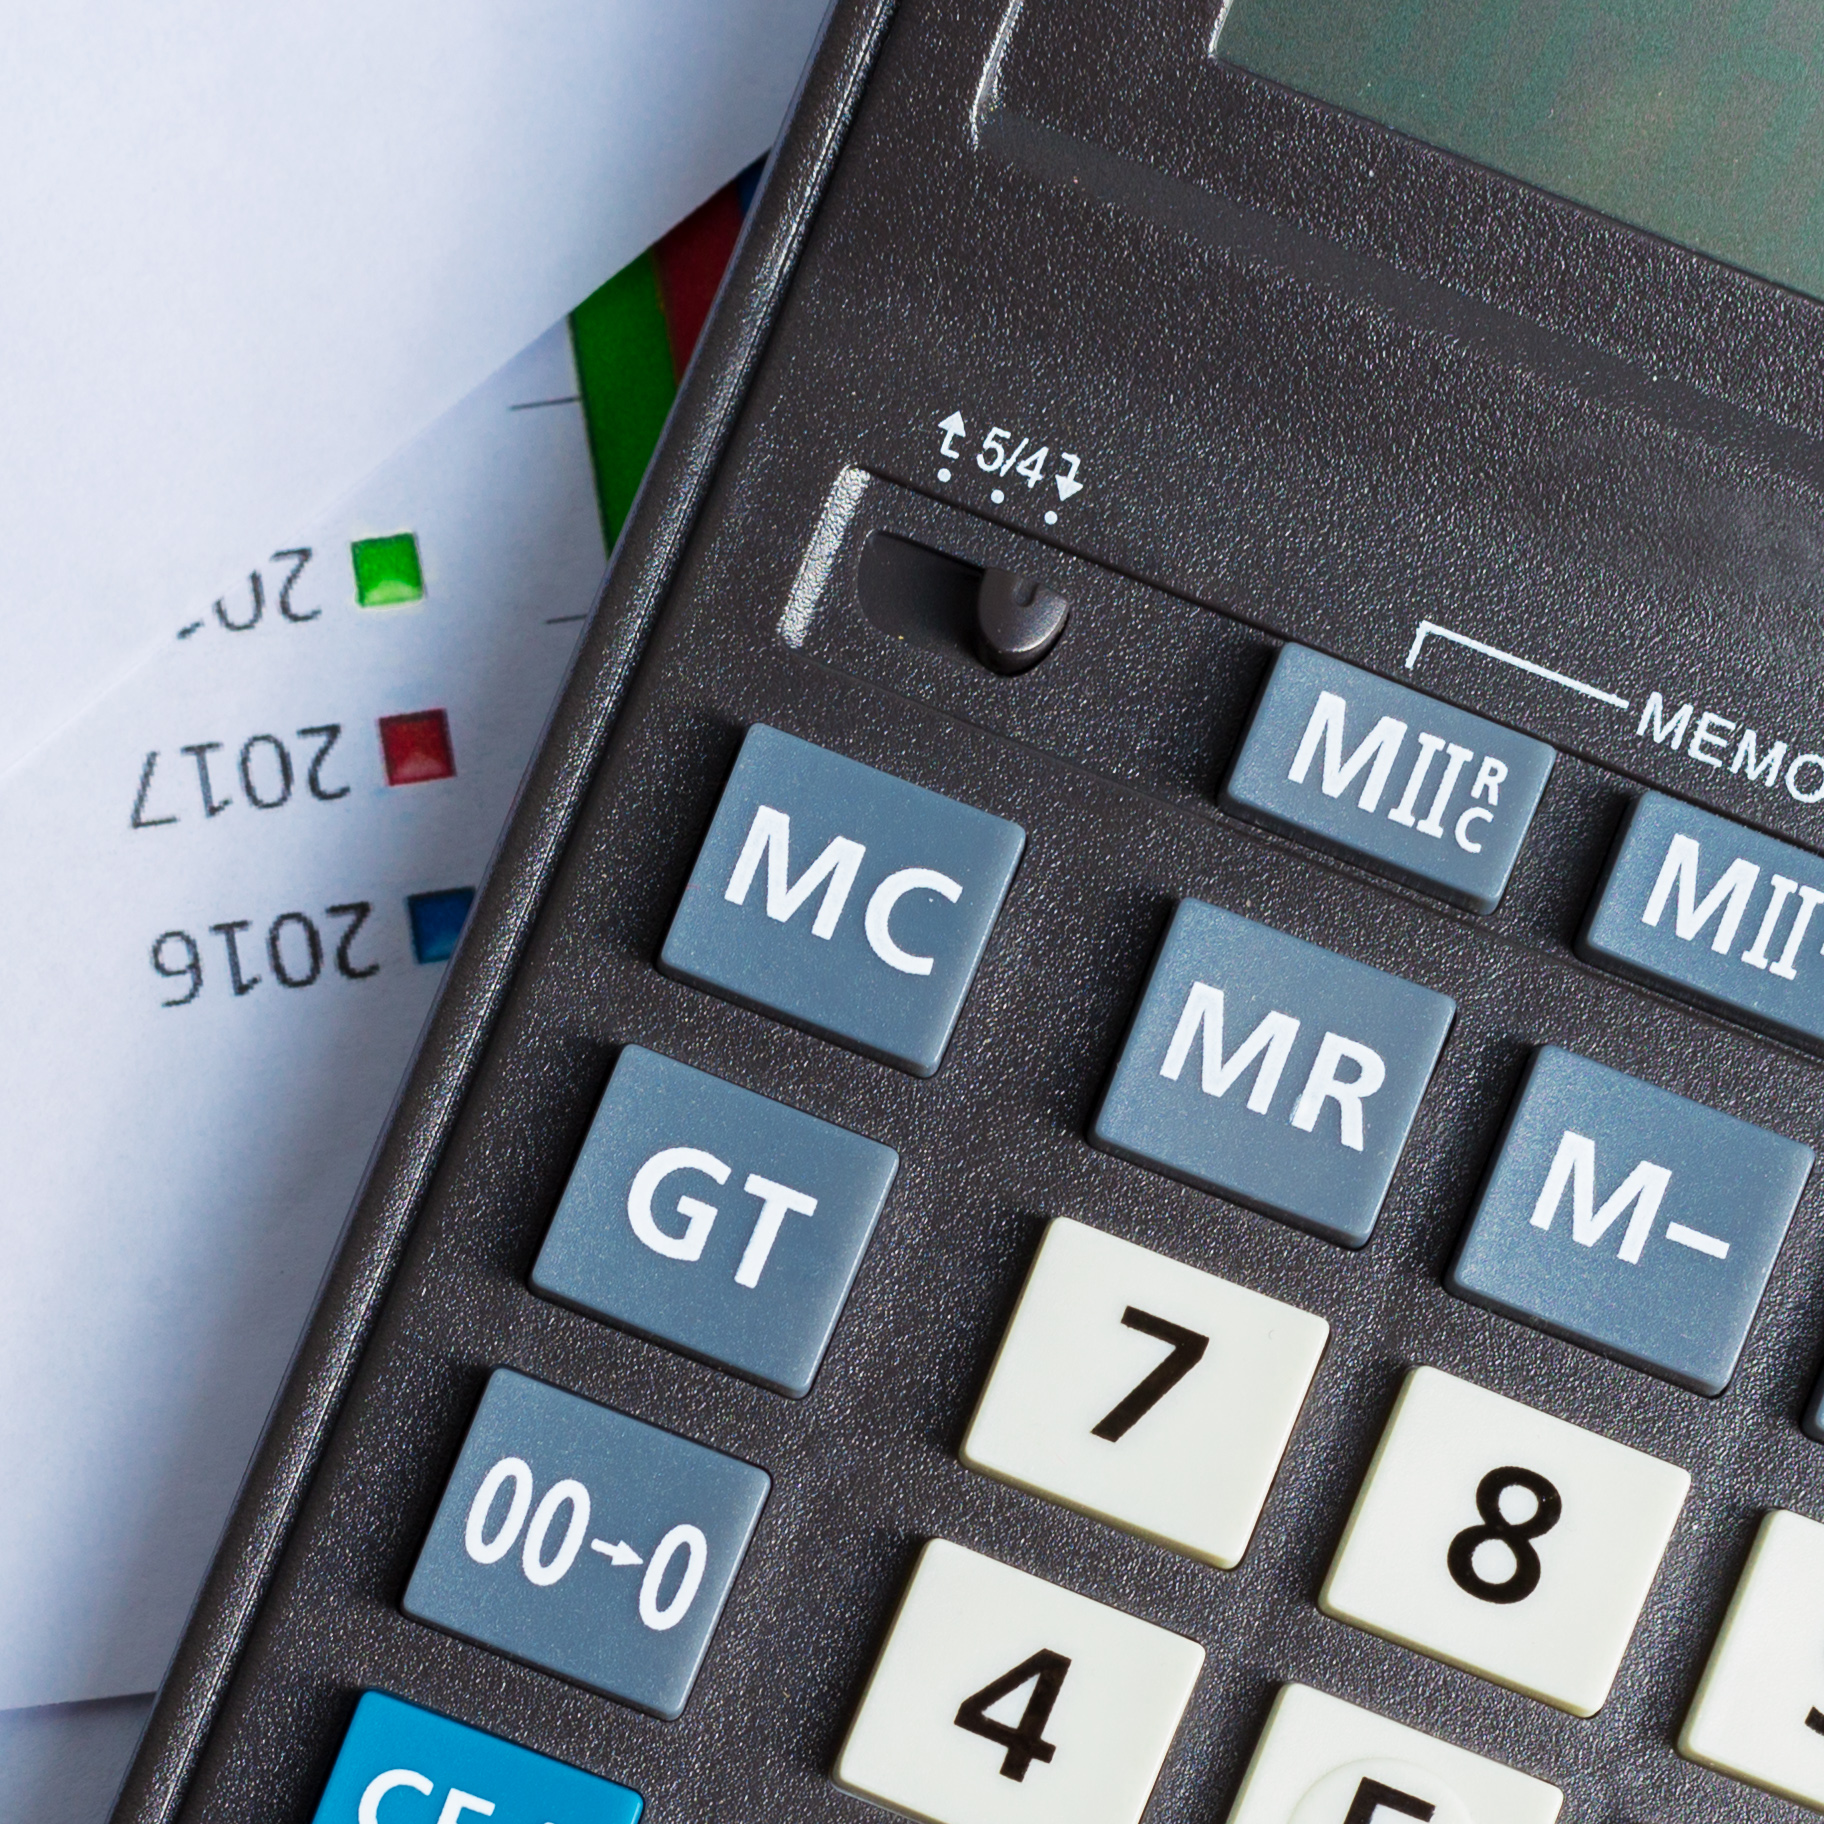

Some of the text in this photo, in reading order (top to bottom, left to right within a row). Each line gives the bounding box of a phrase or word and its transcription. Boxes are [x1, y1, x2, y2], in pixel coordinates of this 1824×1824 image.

[977, 427, 1048, 488] 5/4
[132, 723, 352, 829] 2017
[151, 902, 380, 1008] 2016
[725, 805, 962, 975] MC
[1160, 982, 1385, 1151] MR
[628, 1147, 817, 1288] GT
[1530, 1131, 1729, 1264] M-
[1092, 1306, 1209, 1442] 7
[1447, 1466, 1562, 1604] 8
[954, 1649, 1071, 1782] 4
